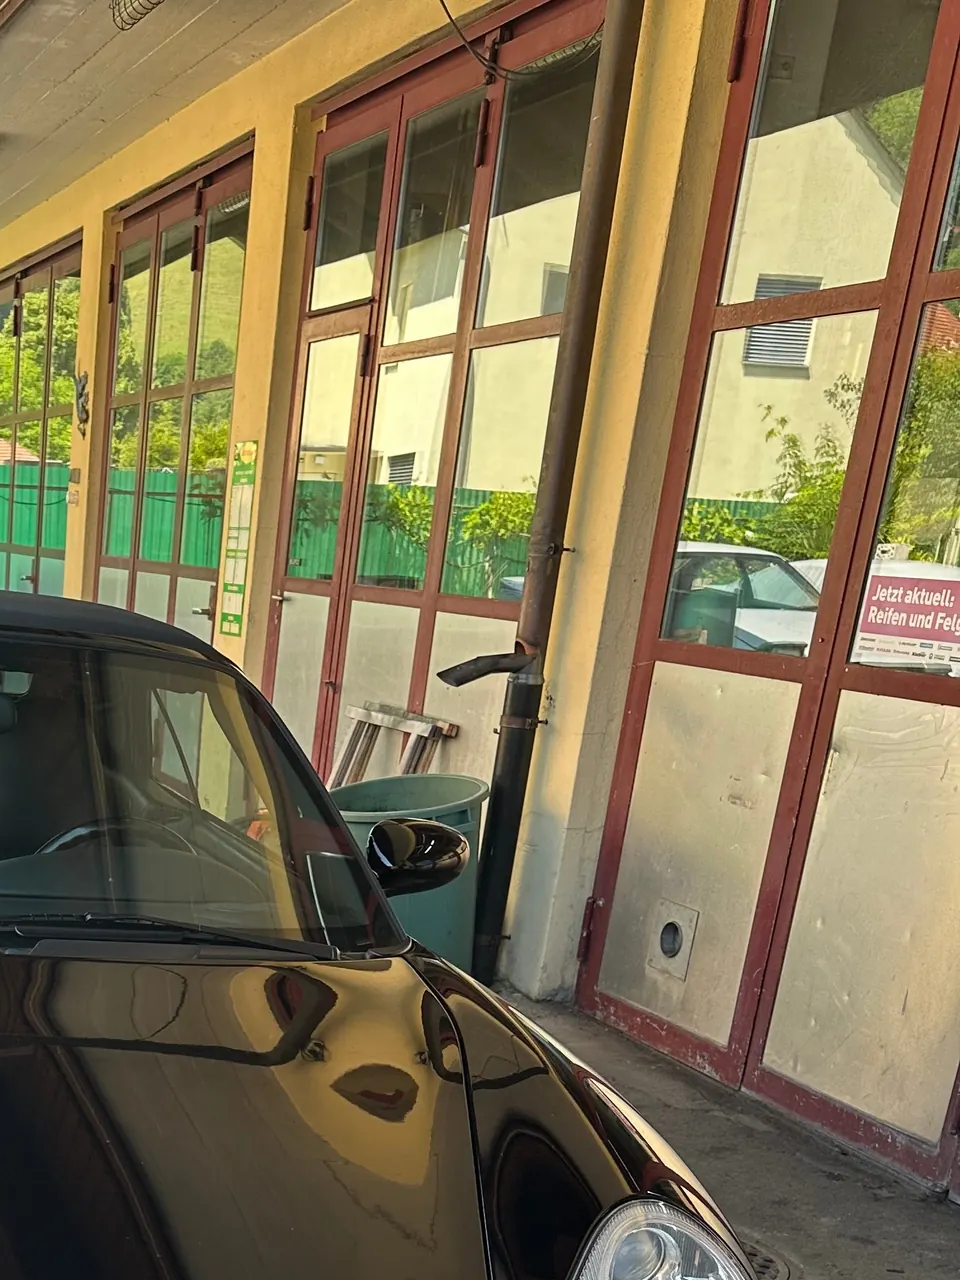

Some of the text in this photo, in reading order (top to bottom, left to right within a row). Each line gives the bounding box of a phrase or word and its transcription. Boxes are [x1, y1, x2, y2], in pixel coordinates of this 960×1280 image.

[872, 584, 956, 608] Jetzt aktuell:
[867, 606, 907, 626] Reifen
[909, 612, 935, 629] und
